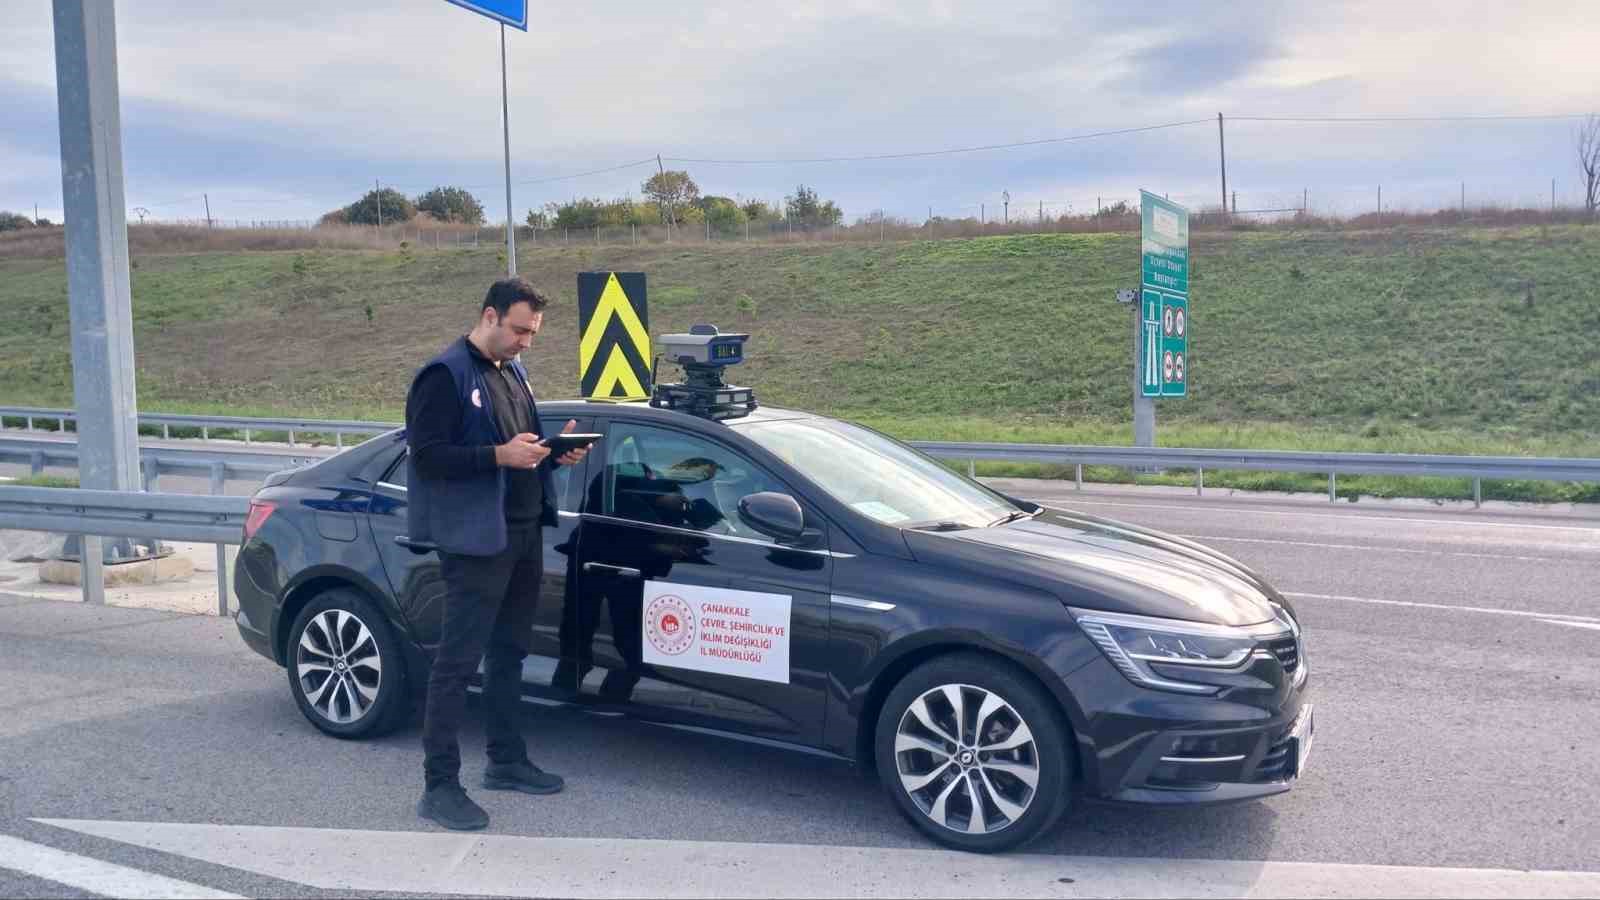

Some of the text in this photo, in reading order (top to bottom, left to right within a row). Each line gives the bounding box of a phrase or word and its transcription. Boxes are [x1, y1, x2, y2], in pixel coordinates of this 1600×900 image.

[701, 603, 750, 617] ÇANAKKALE
[701, 618, 785, 637] ÇEVRE, ŞEHİRCİLİK VE
[701, 631, 772, 649] İKLİM DEĞİŞİKLİĞİ
[700, 647, 761, 662] İL MÜDÜRLÜĞÜ
